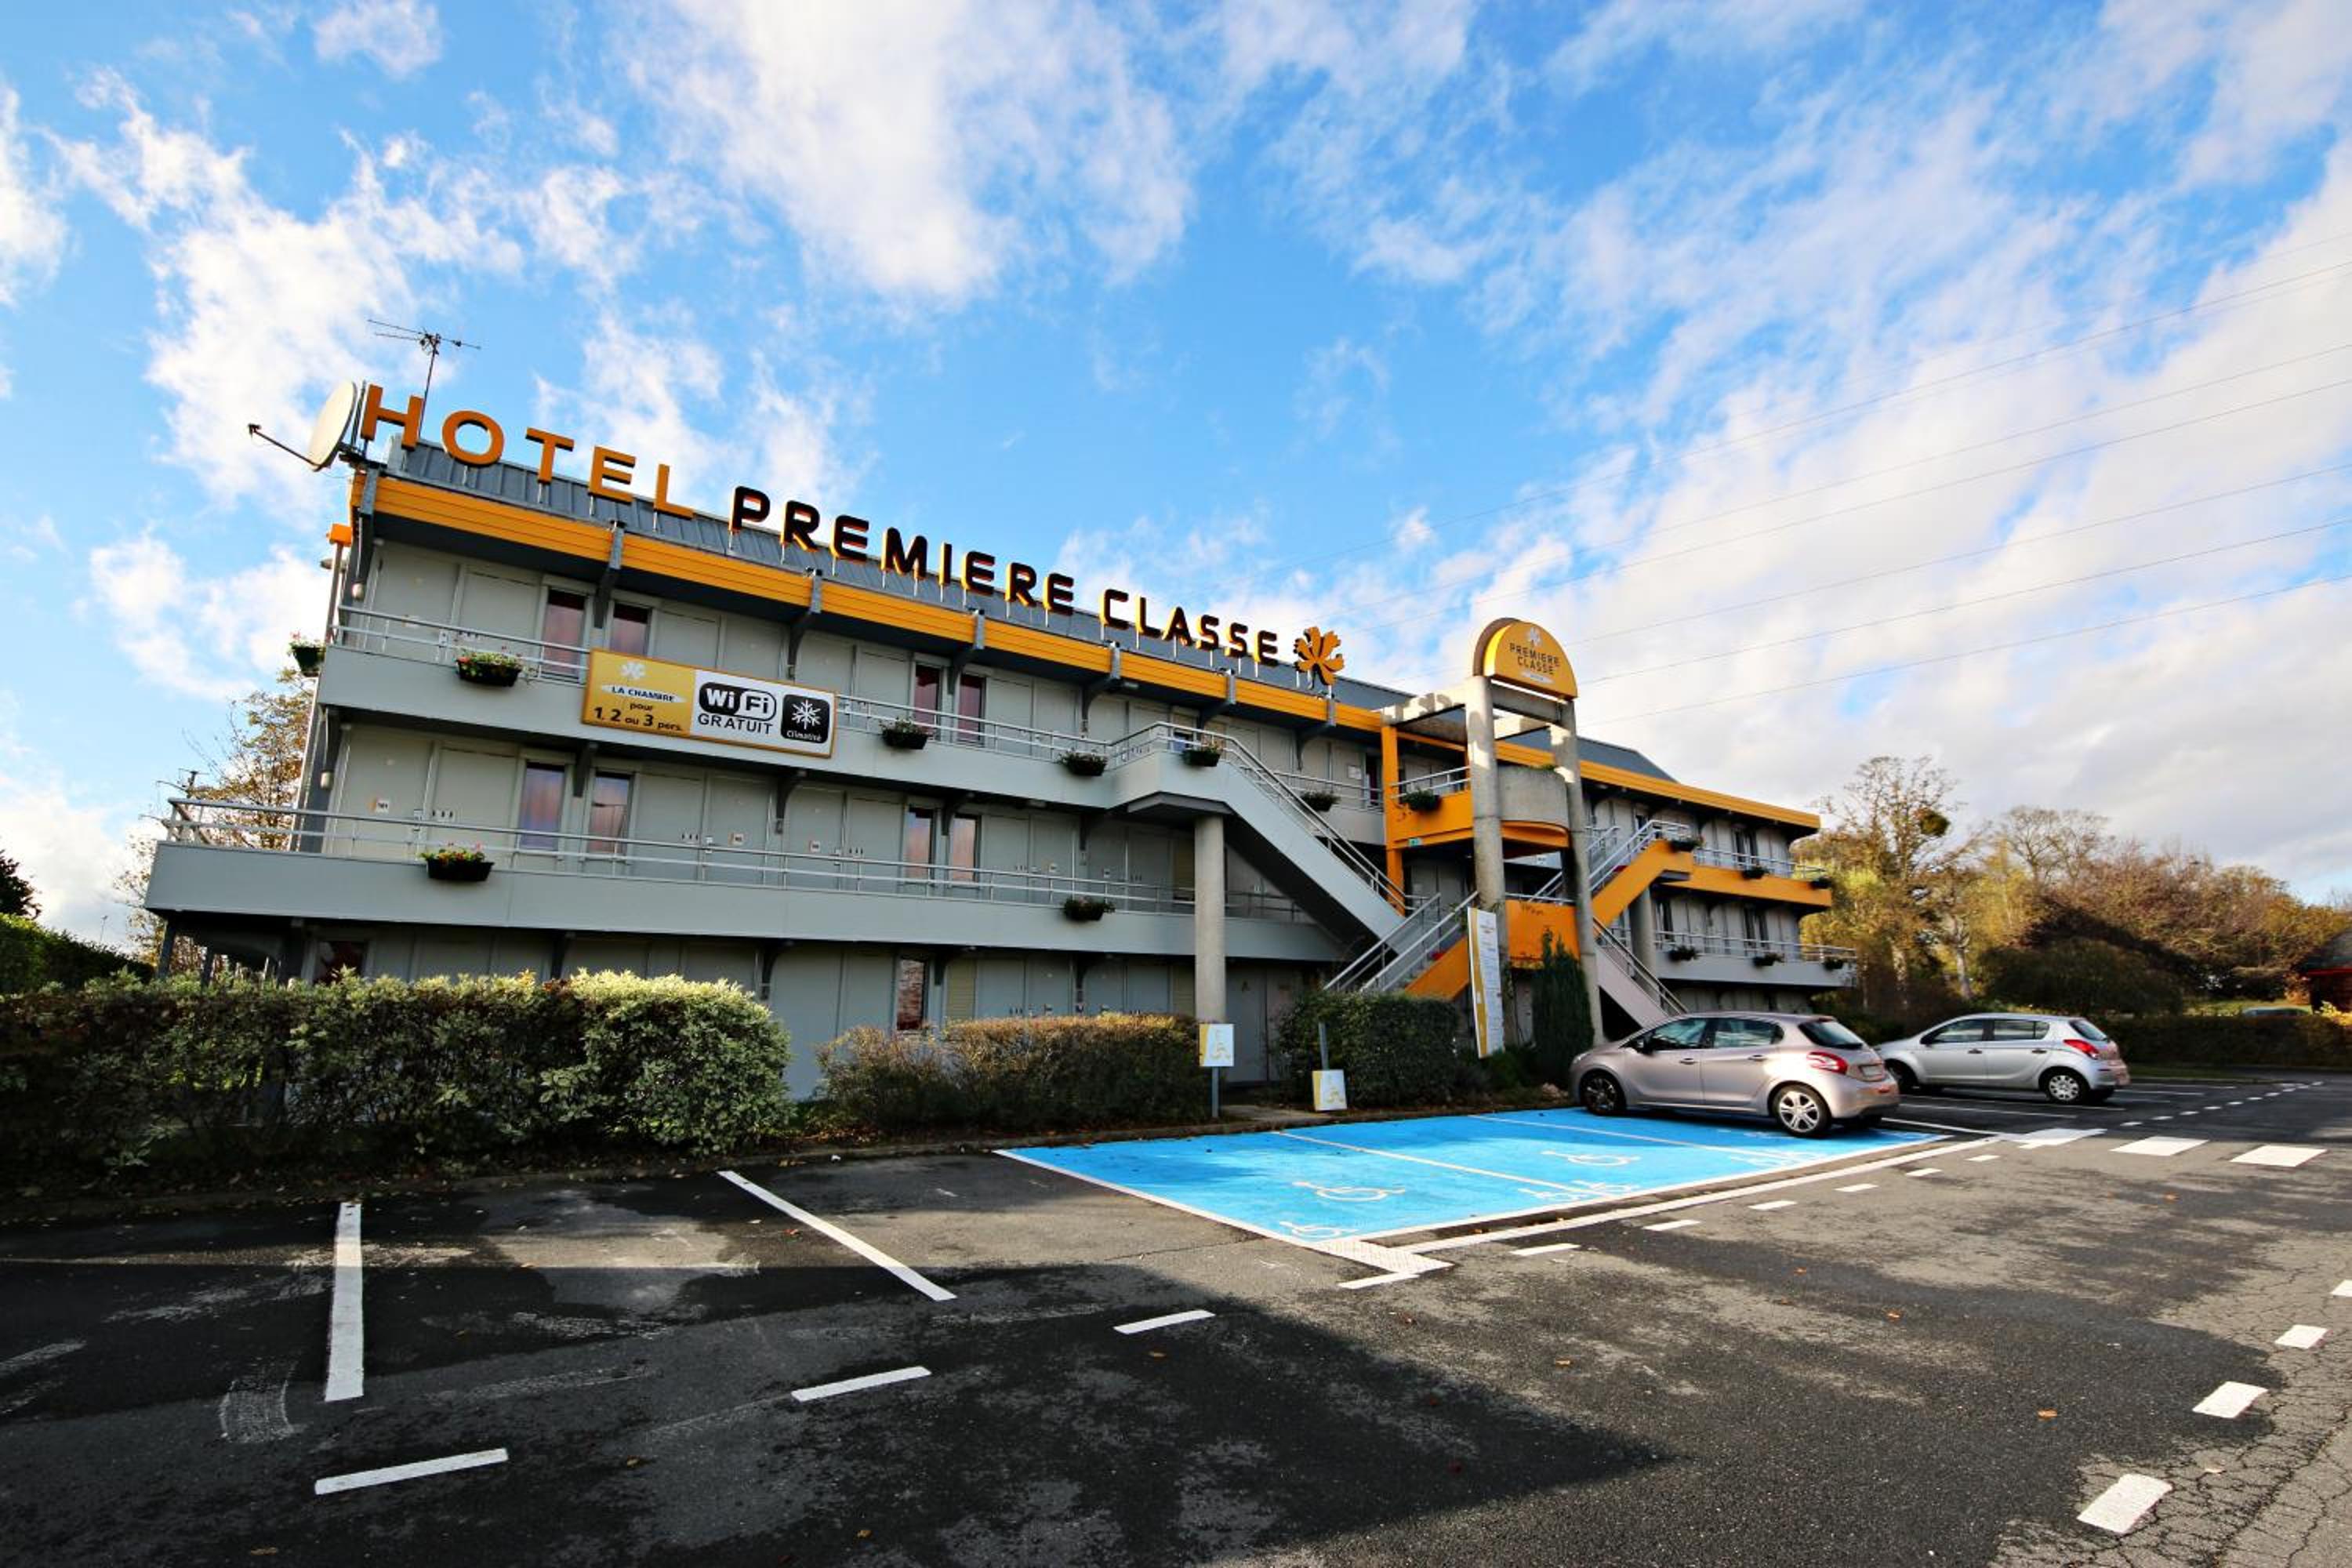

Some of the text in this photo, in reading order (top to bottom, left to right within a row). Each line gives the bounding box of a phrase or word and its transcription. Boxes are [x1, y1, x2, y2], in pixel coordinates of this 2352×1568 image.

[360, 383, 1278, 666] HOTEL PREMIERE CLASSE
[1509, 643, 1560, 667] PREMIERE
[1517, 656, 1555, 675] CLASSE
[612, 686, 675, 702] LA CHAMBRE
[610, 708, 622, 722] 2
[625, 717, 639, 725] ou
[643, 714, 654, 727] 3
[697, 713, 773, 735] GRATUIT
[786, 730, 822, 742] Climatisé
